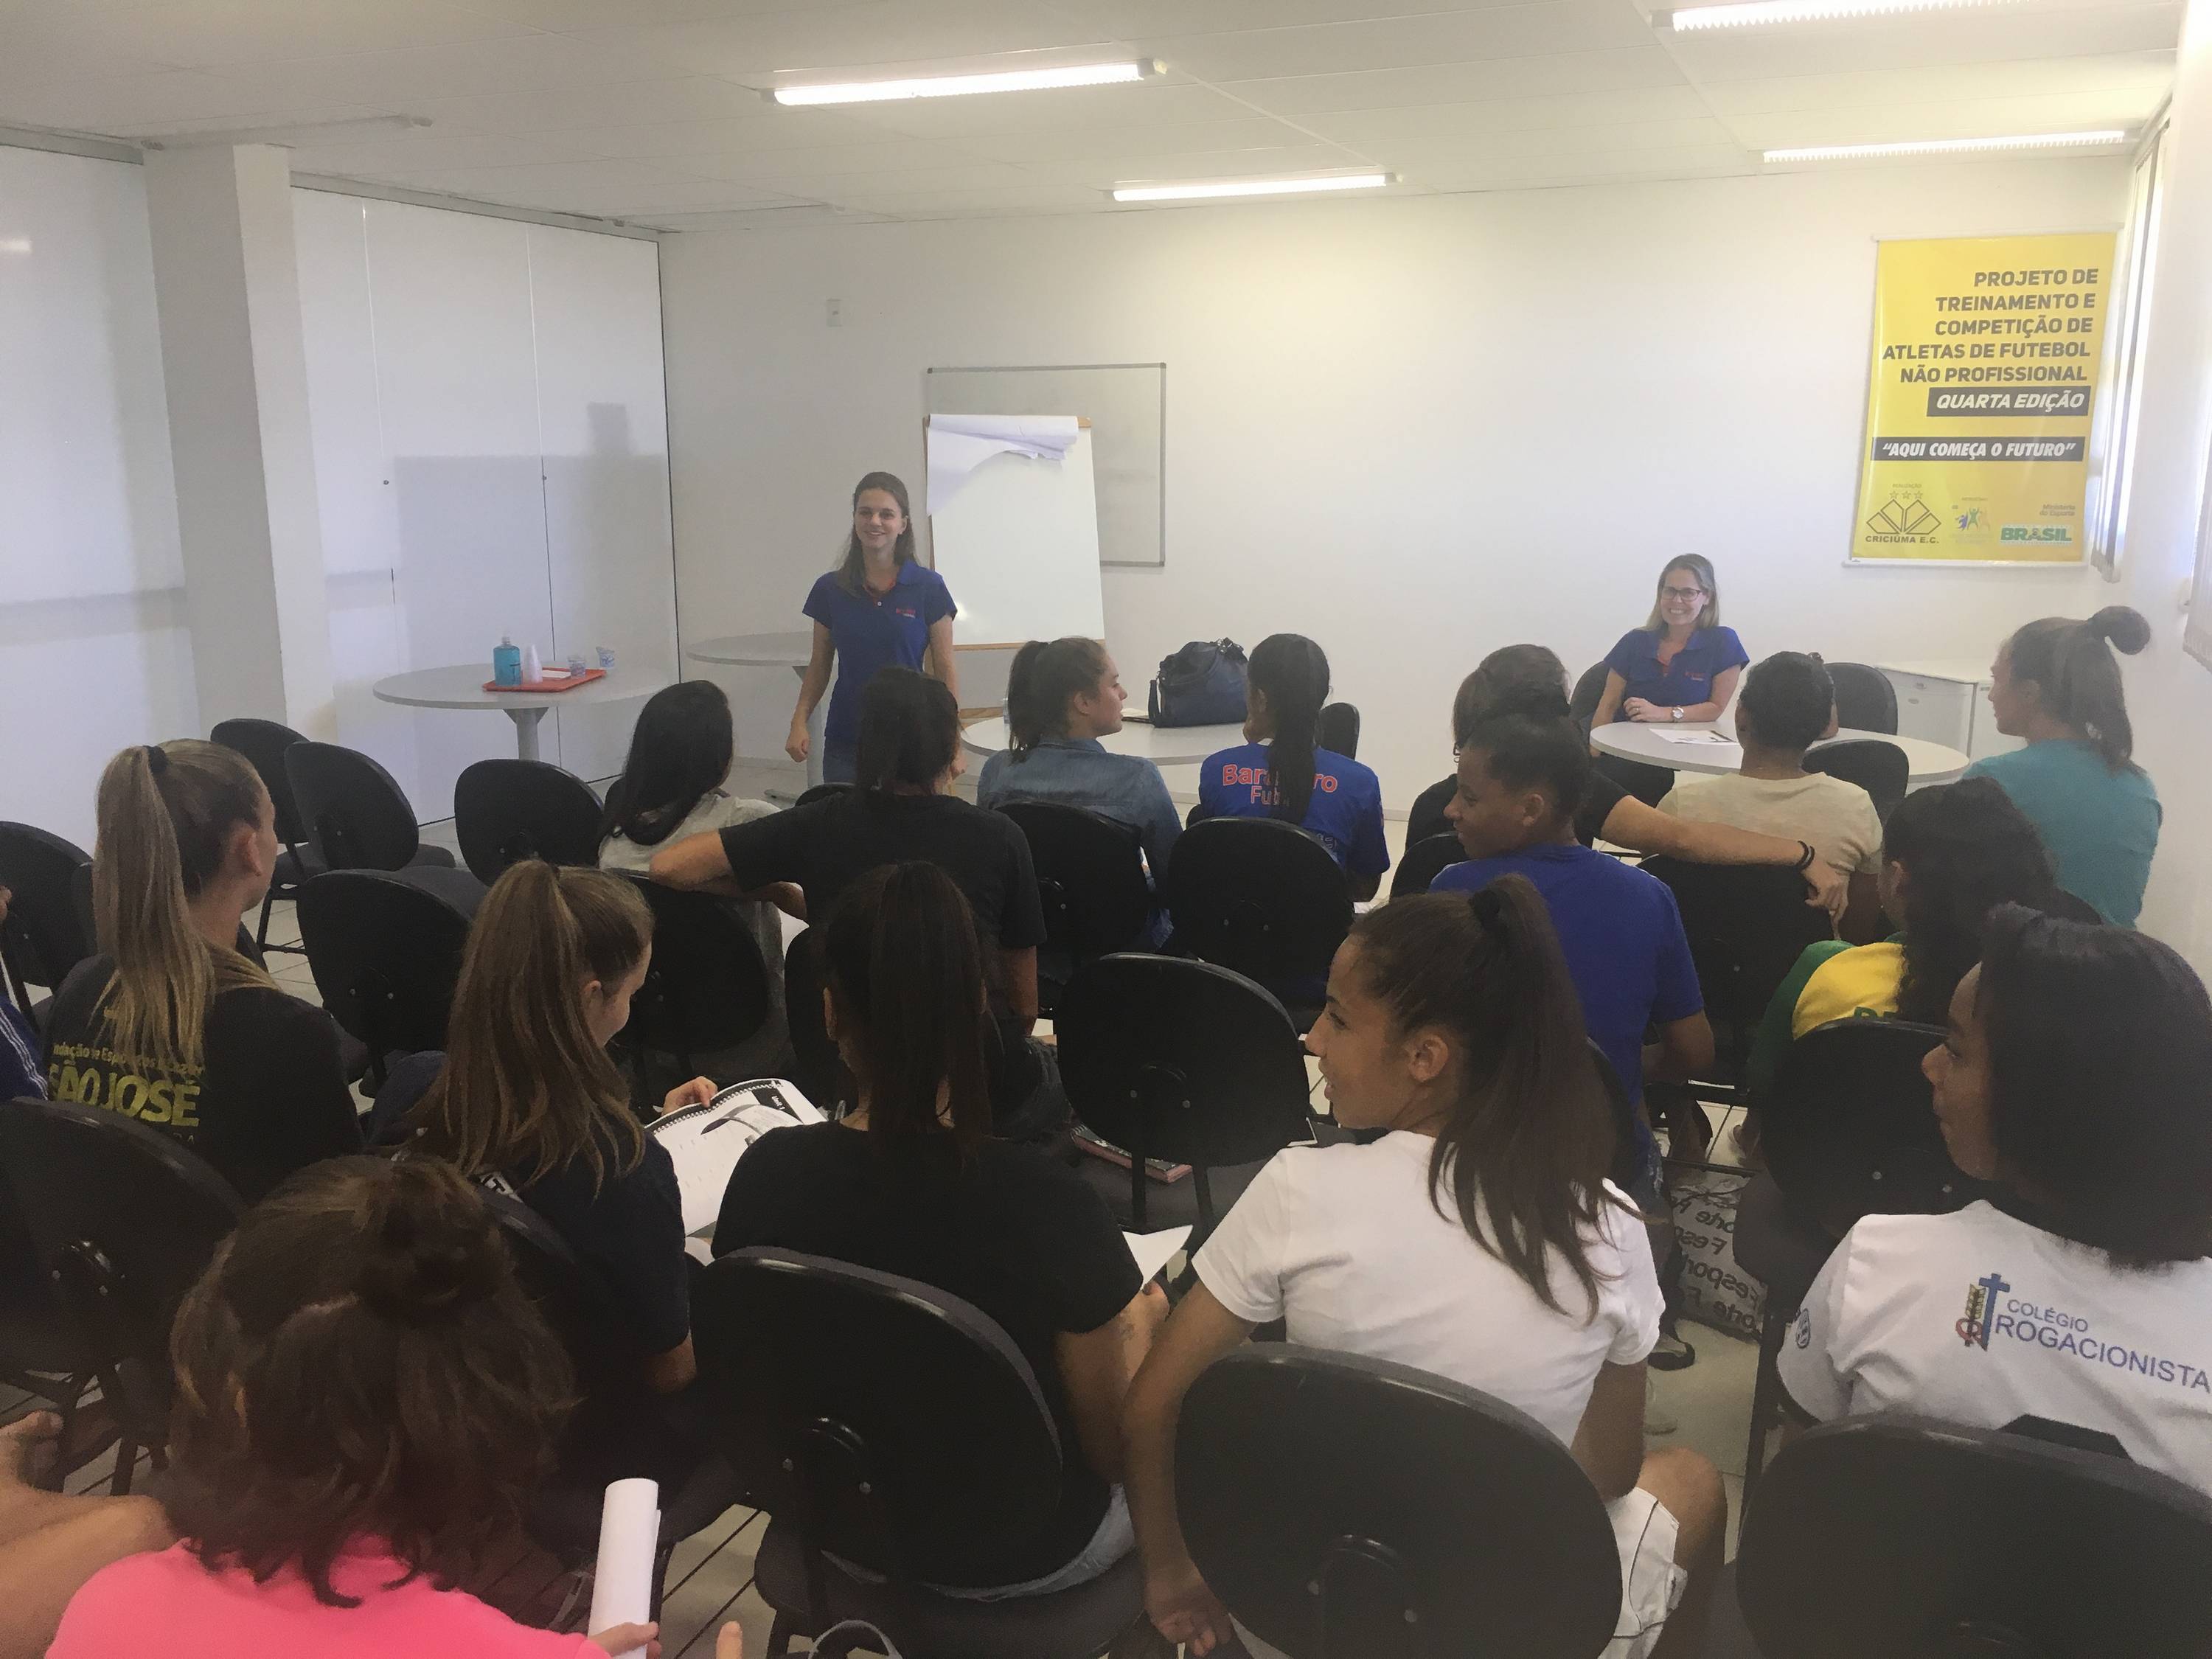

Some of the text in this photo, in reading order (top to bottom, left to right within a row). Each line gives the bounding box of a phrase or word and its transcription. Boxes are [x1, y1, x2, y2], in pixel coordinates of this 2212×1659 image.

[1974, 268, 2098, 287] PROJETO DE
[1935, 293, 2096, 311] TREINAMENTO E
[1935, 316, 2093, 338] COMPETIÇÃO DE
[1883, 341, 2090, 360] ATLETAS DE FUTEBOL
[1900, 364, 2087, 383] NÃO PROFISSIONAL
[1936, 389, 2084, 413] QUARTA EDIÇÃO
[1929, 442, 1986, 461] COMEÇA
[1991, 443, 2003, 456] O
[1865, 534, 1916, 543] CRICIÚMA
[2000, 527, 2072, 542] BRASIL
[2007, 1299, 2088, 1333] COLÉGIO
[1994, 1315, 2211, 1394] ROGACIONISTA
